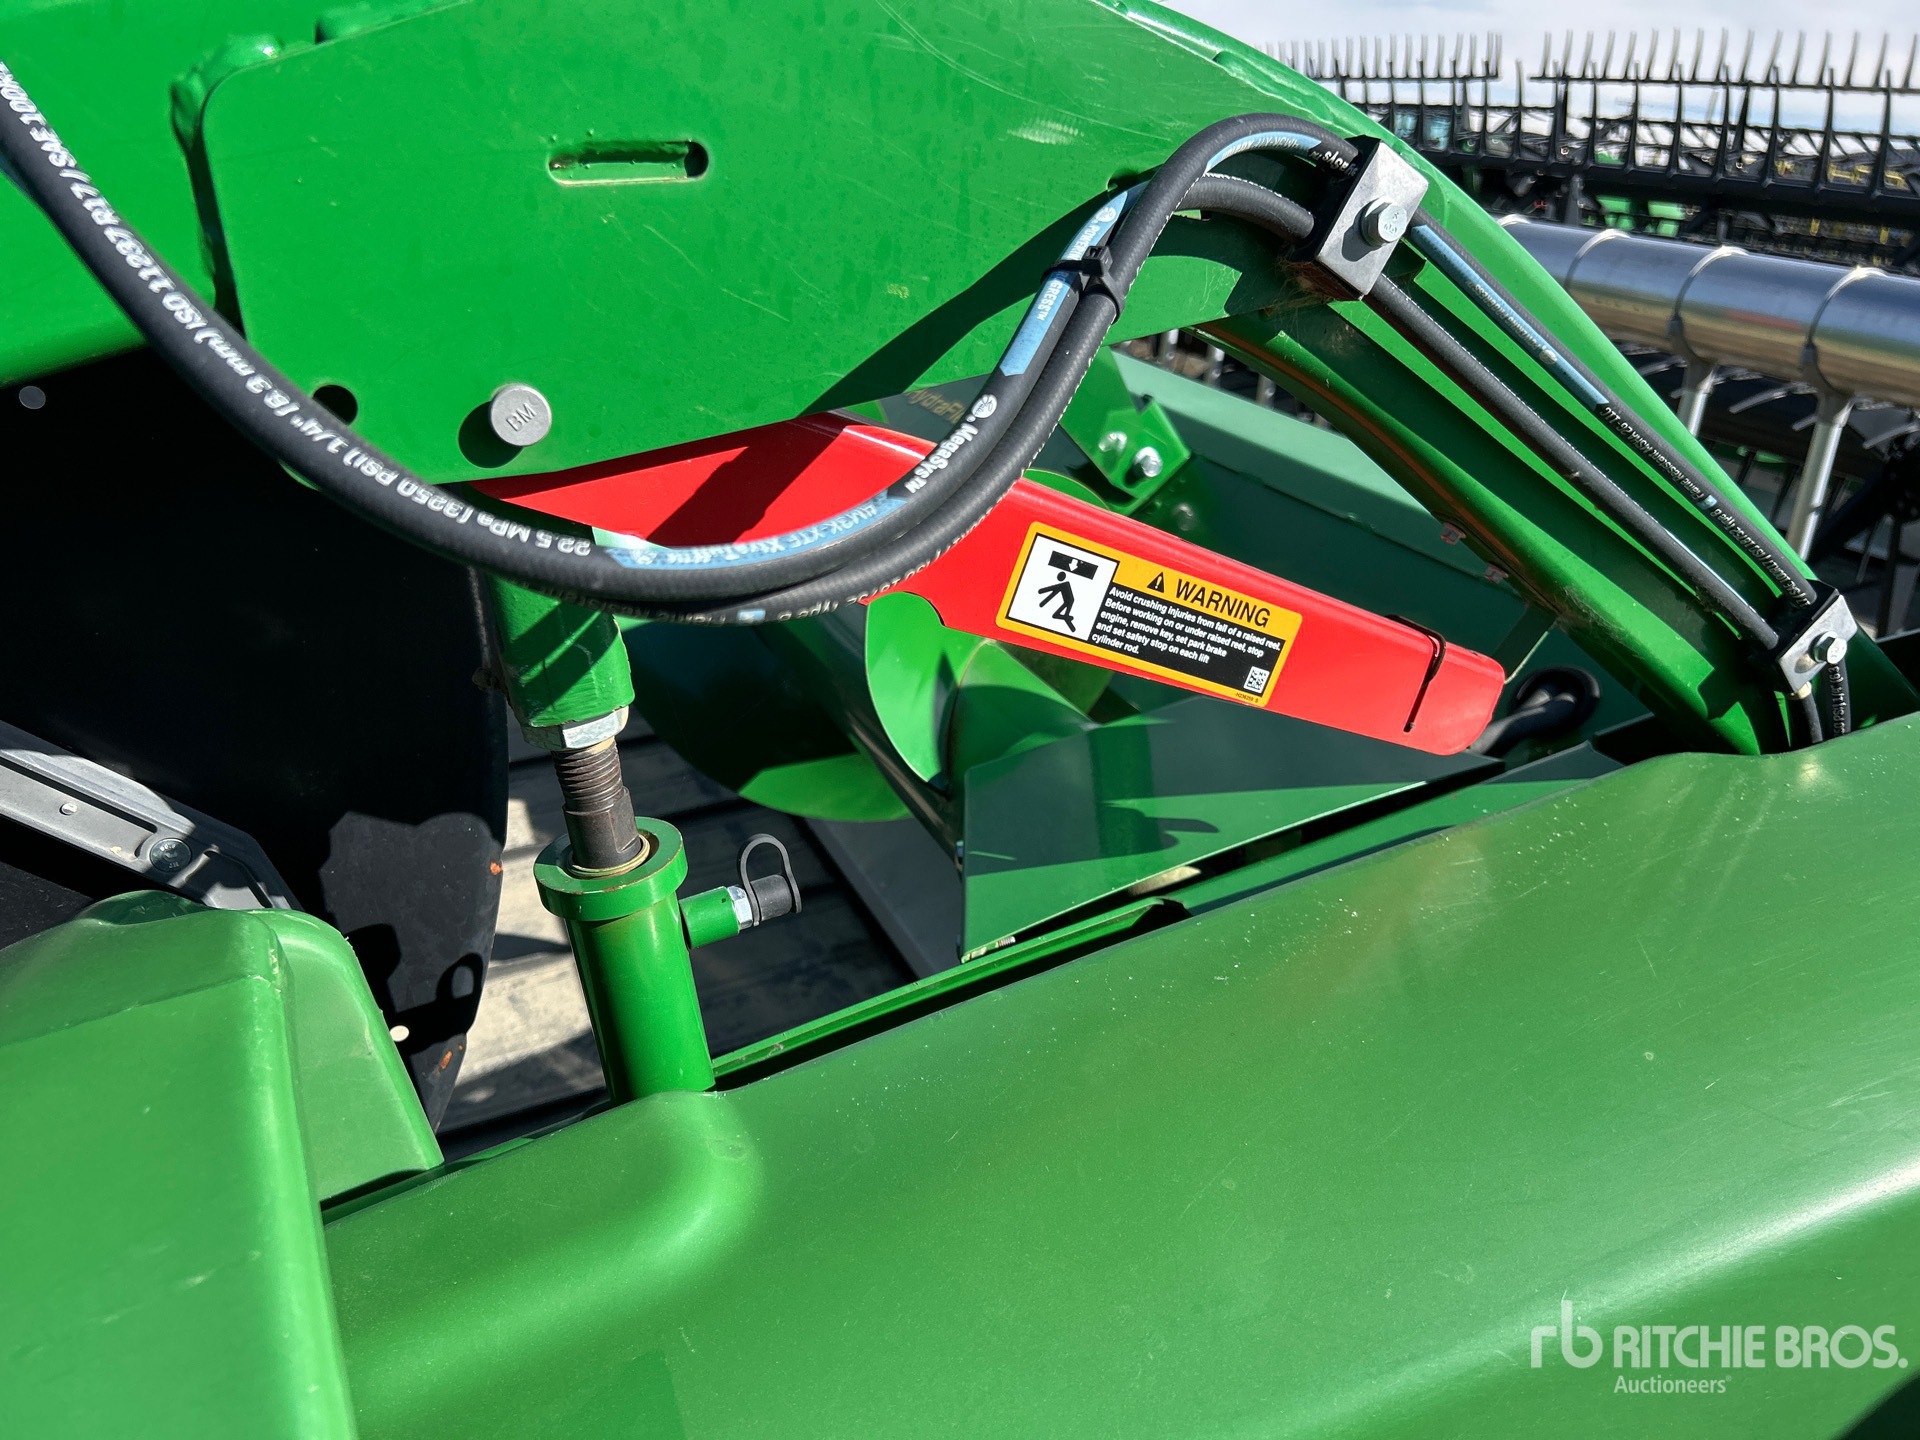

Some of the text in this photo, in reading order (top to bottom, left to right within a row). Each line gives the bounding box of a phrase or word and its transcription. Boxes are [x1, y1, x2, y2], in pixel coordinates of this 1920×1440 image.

[29, 126, 77, 166] SAE
[69, 183, 121, 225] R17
[102, 227, 175, 292] 11237
[1036, 222, 1100, 321] POWERIN ROGRESS™
[160, 291, 208, 328] ISO
[194, 327, 255, 376] mm)
[1504, 315, 1540, 350] POWERING
[504, 400, 537, 432] BM
[1627, 430, 1652, 452] MSHA
[1647, 448, 1683, 481] Resistant
[395, 476, 474, 524] (3250
[1680, 477, 1703, 500] Flame
[474, 510, 532, 541] MPa
[532, 528, 589, 556] 22.5
[1108, 586, 1133, 602] Avoid
[1131, 594, 1168, 615] crushing
[1166, 606, 1196, 624] injuries
[1195, 616, 1215, 629] from
[1214, 621, 1228, 633] fall
[1227, 625, 1237, 636] of
[1241, 630, 1266, 645] raised
[1264, 638, 1281, 651] reel.
[1172, 578, 1272, 628] WARNING
[1090, 632, 1140, 654] cylinder rod.
[1095, 621, 1210, 664] and set safety stop on each lift
[1099, 610, 1227, 657] engine, remove key, set park brake
[1104, 598, 1264, 659] Before working on or under raised reel, stop
